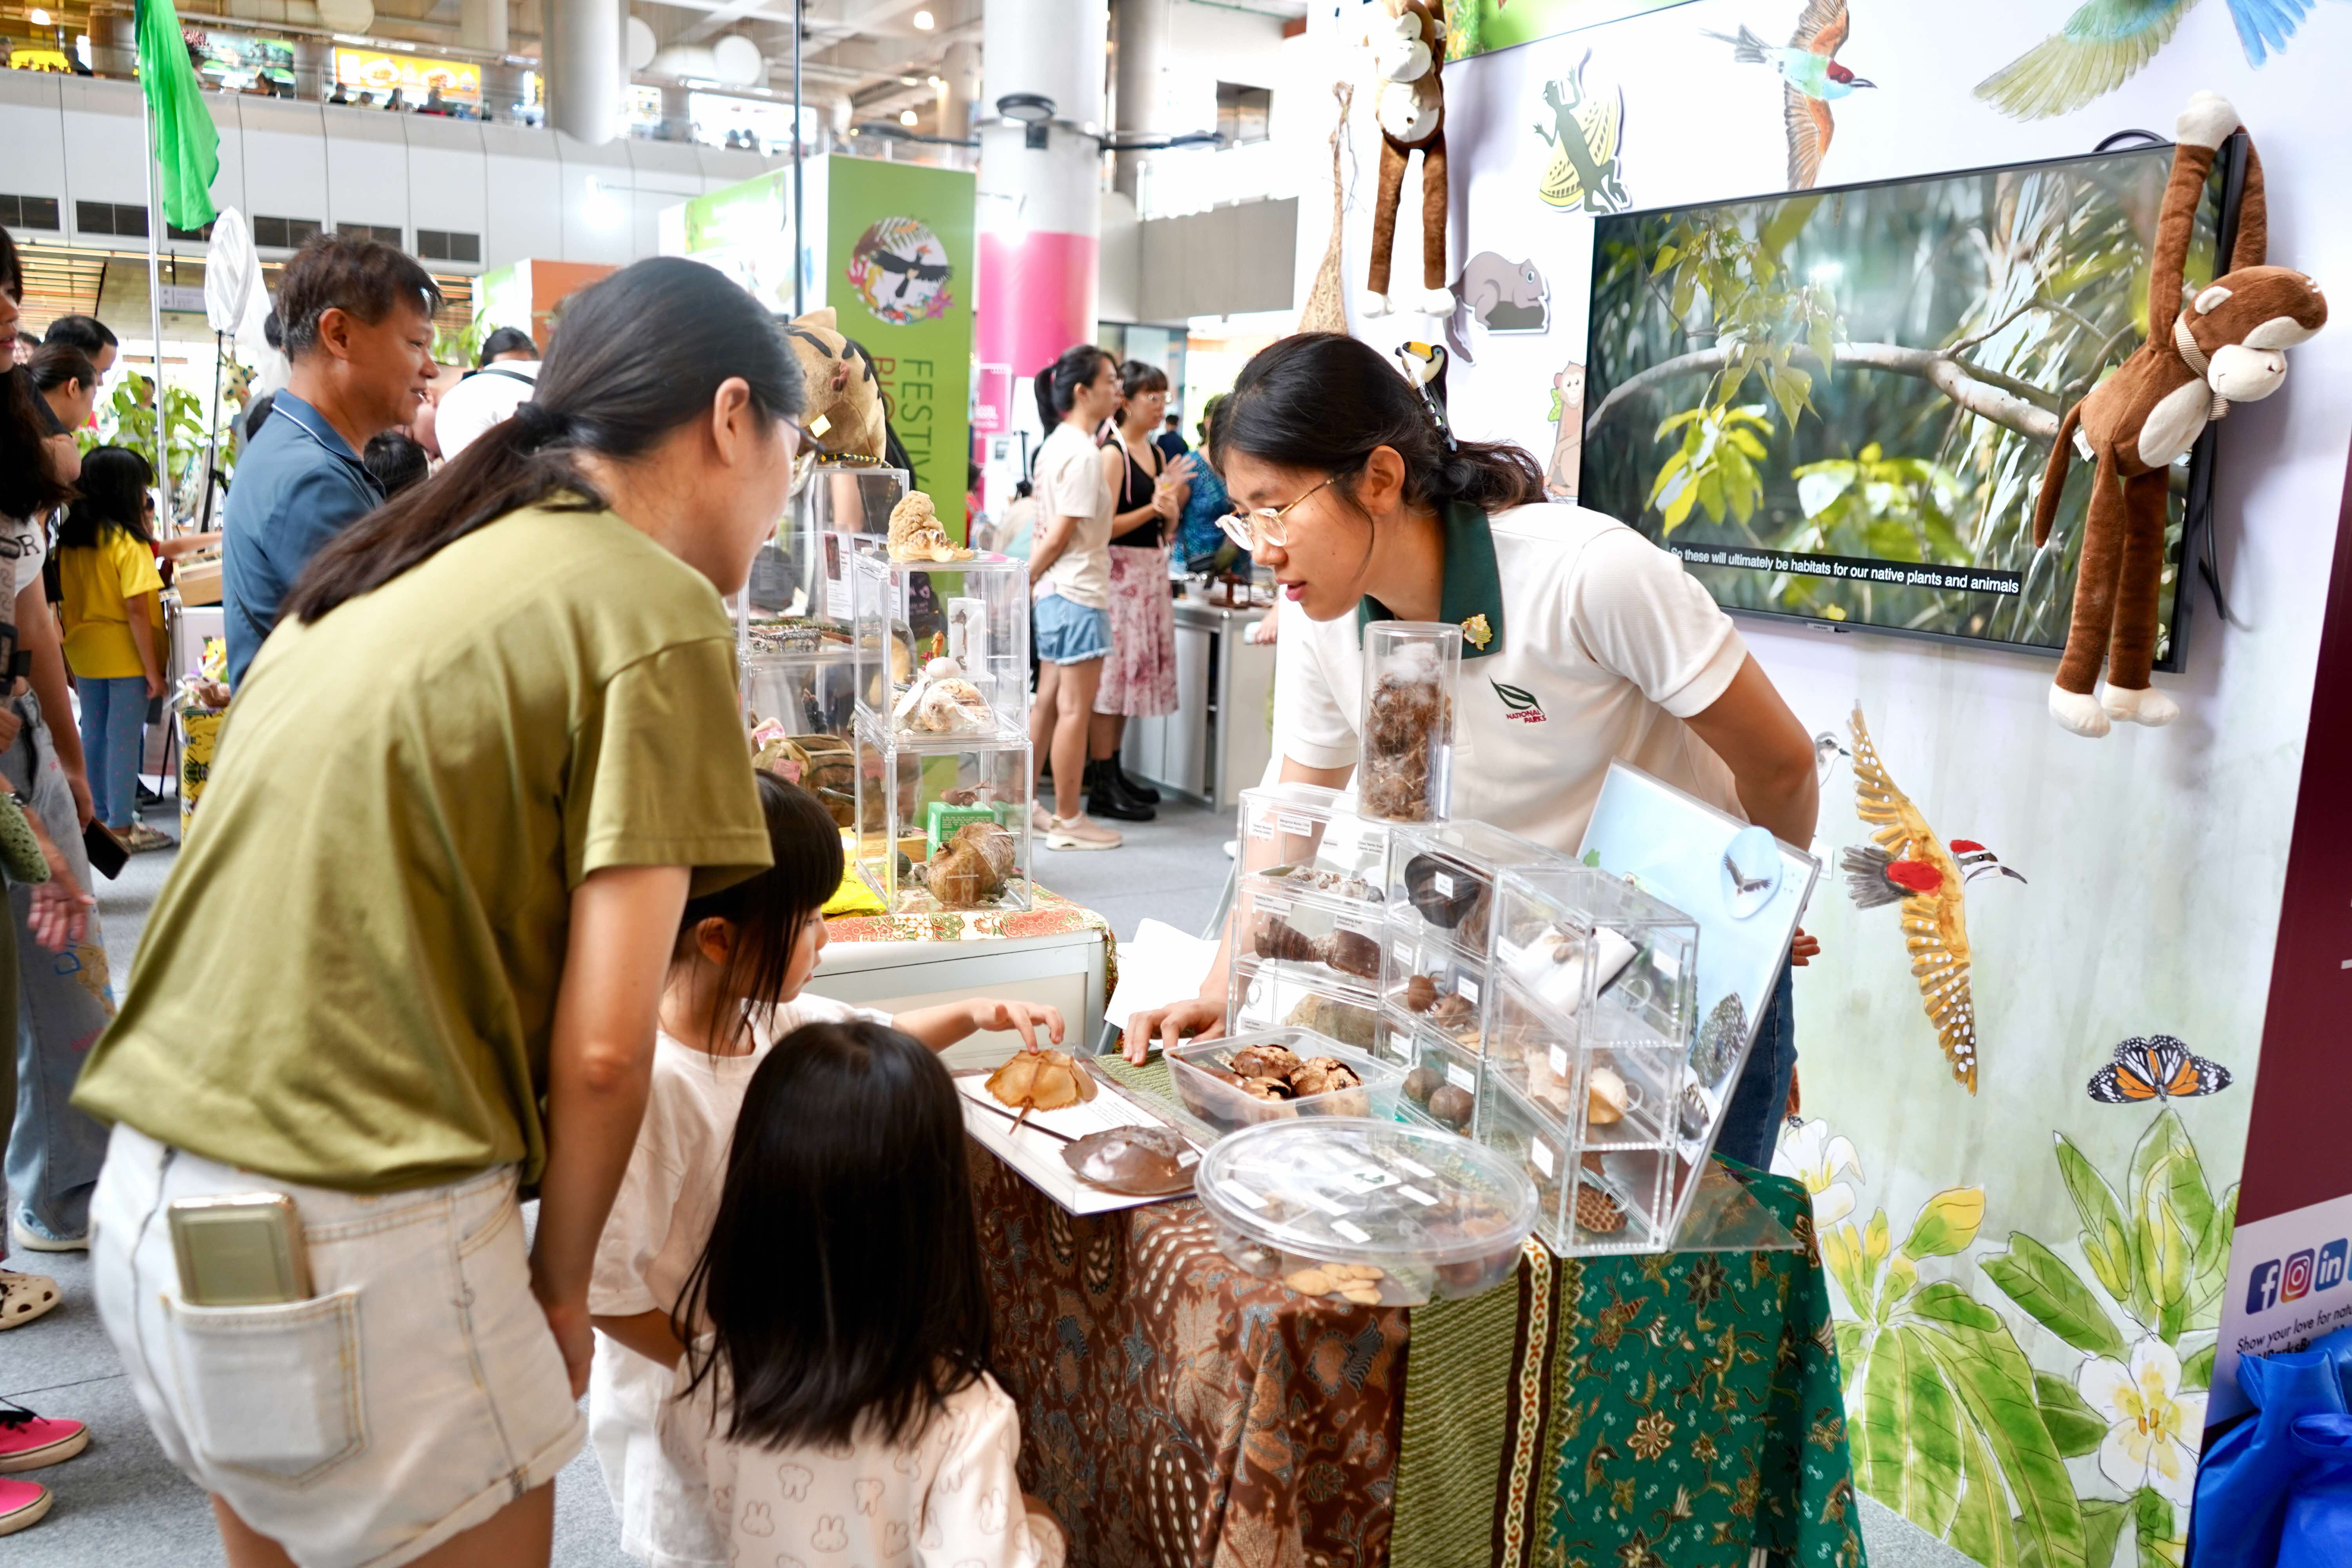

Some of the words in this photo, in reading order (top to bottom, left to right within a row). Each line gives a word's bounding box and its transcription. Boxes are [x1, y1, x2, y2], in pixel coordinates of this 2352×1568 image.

[900, 358, 933, 490] FESTIV
[1685, 549, 1710, 563] these
[1711, 552, 1726, 564] will
[1728, 553, 1774, 571] ultimately
[1775, 557, 1788, 570] be
[1791, 559, 1831, 575] habitats
[1833, 562, 1849, 576] for
[1850, 567, 1869, 578] our
[1871, 568, 1904, 582] native
[1907, 570, 1942, 586] plants
[1945, 575, 1968, 588] and
[1971, 577, 2019, 593] animals
[1505, 710, 1541, 719] NATIONAL
[1524, 715, 1546, 724] PARKS
[2238, 1336, 2265, 1352] Show
[2267, 1327, 2291, 1348] your
[2293, 1318, 2314, 1334] love
[2317, 1309, 2332, 1326] for
